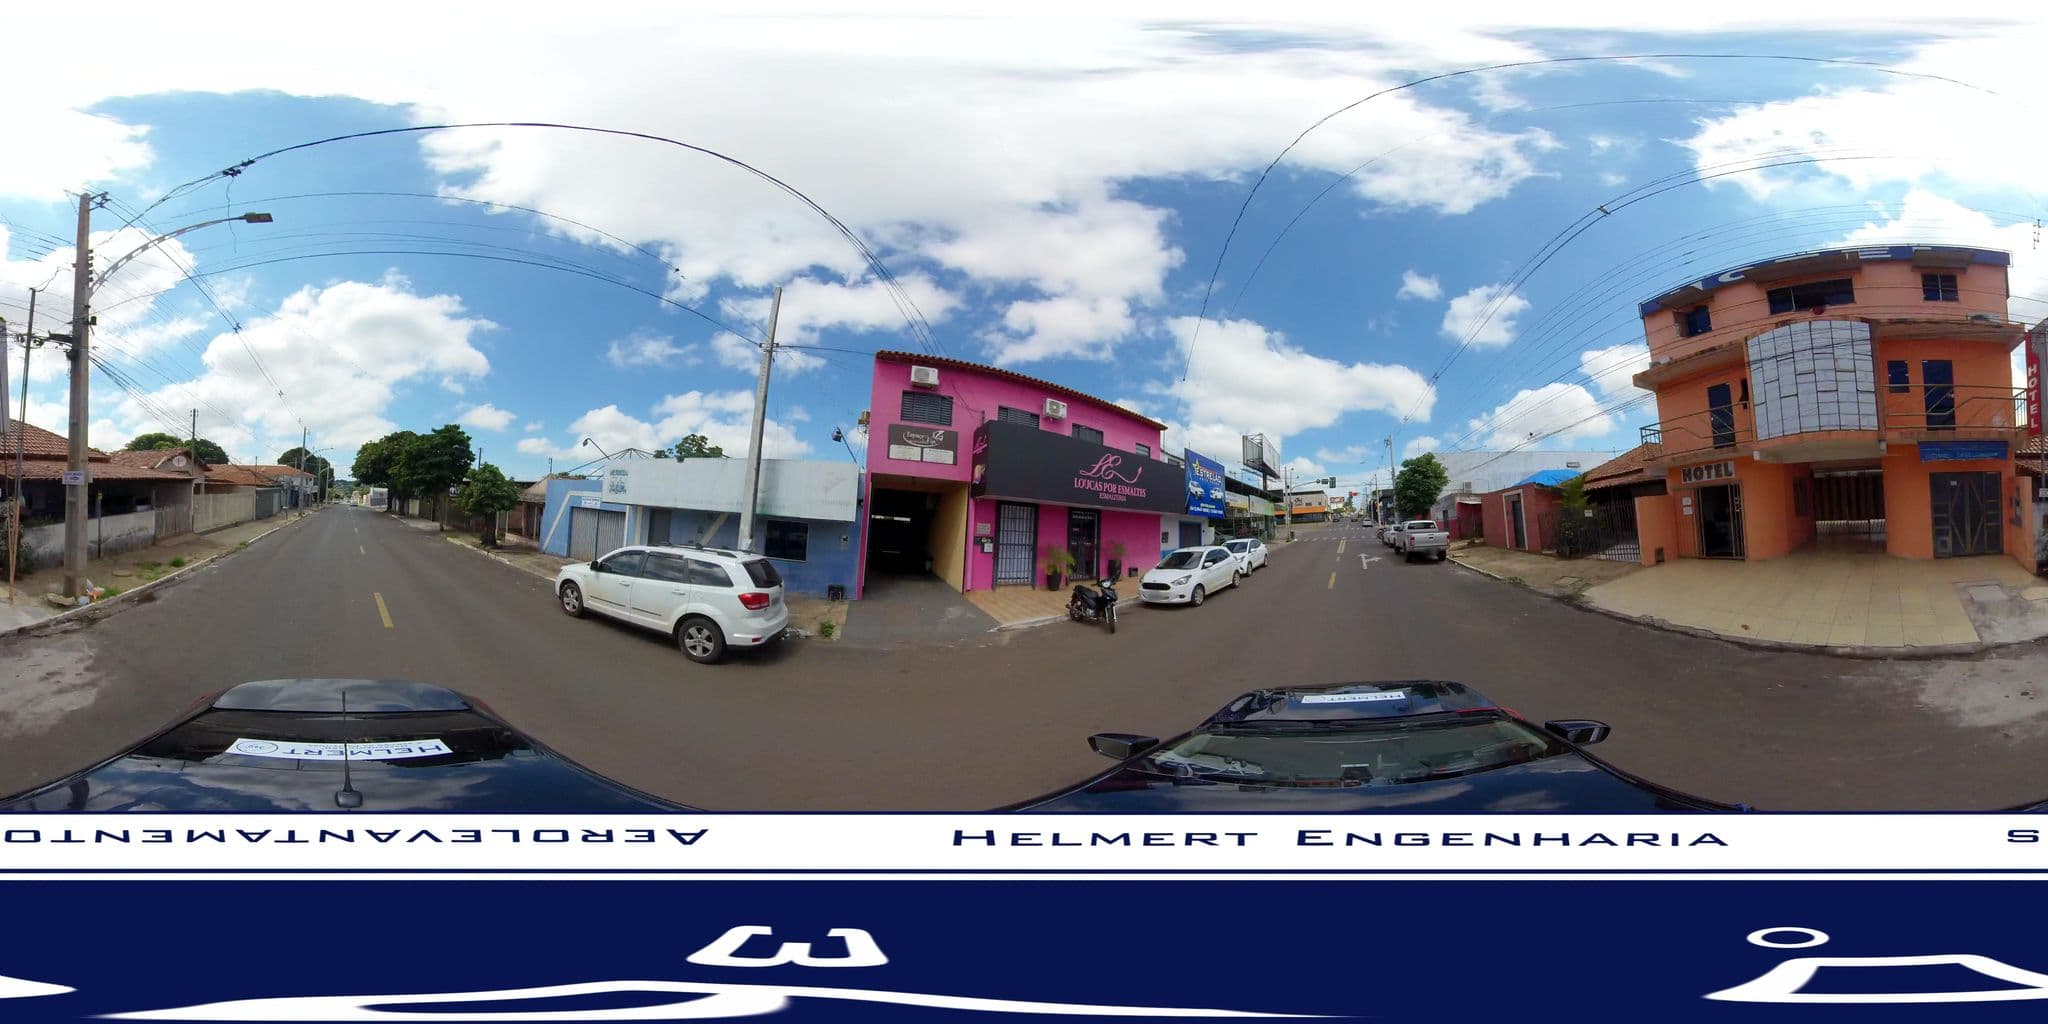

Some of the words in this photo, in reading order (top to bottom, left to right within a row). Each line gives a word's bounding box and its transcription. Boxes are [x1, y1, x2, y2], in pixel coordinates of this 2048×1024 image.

[2028, 363, 2039, 428] HOTEL
[1681, 463, 1733, 482] HOTEL
[1074, 477, 1103, 492] LOUCAS
[1103, 482, 1117, 493] POR
[1118, 485, 1147, 498] ESMALTES
[283, 744, 443, 756] HELMERT
